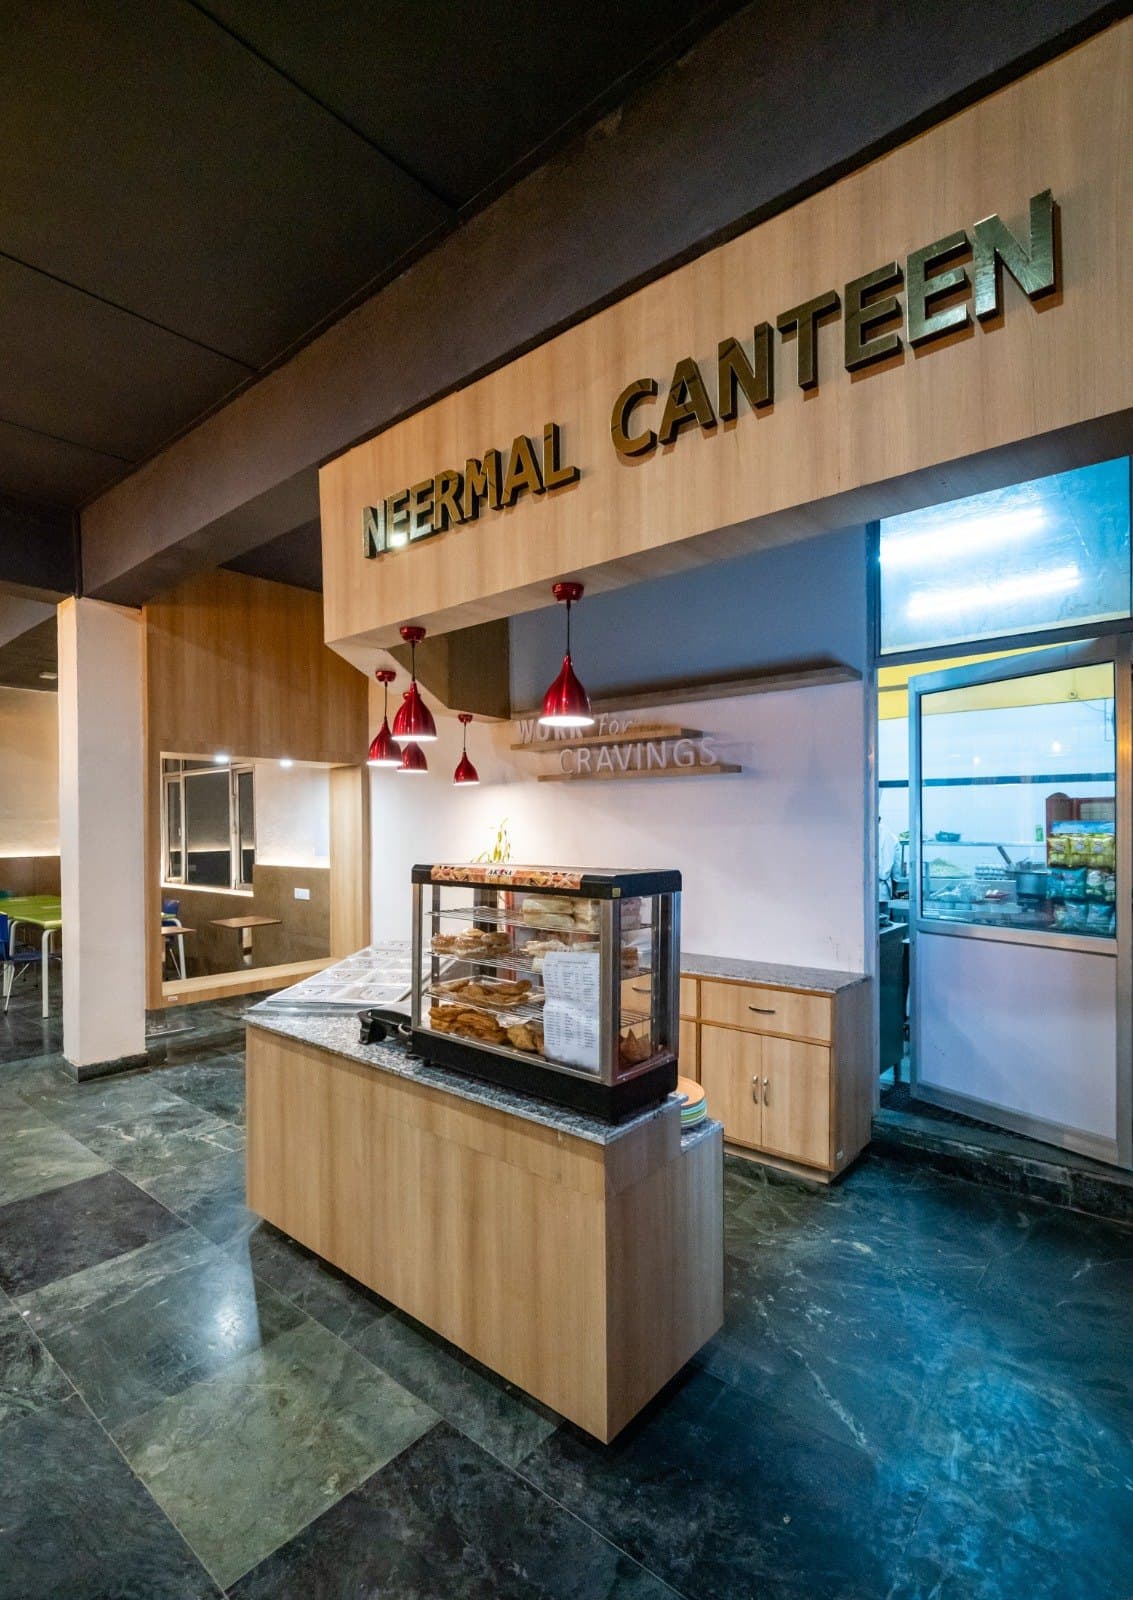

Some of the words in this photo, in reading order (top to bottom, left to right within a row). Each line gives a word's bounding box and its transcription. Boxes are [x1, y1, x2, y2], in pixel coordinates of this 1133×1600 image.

[362, 422, 580, 559] NEERMAL
[609, 188, 1057, 458] CANTEEN
[559, 737, 718, 774] CRAVINGS
